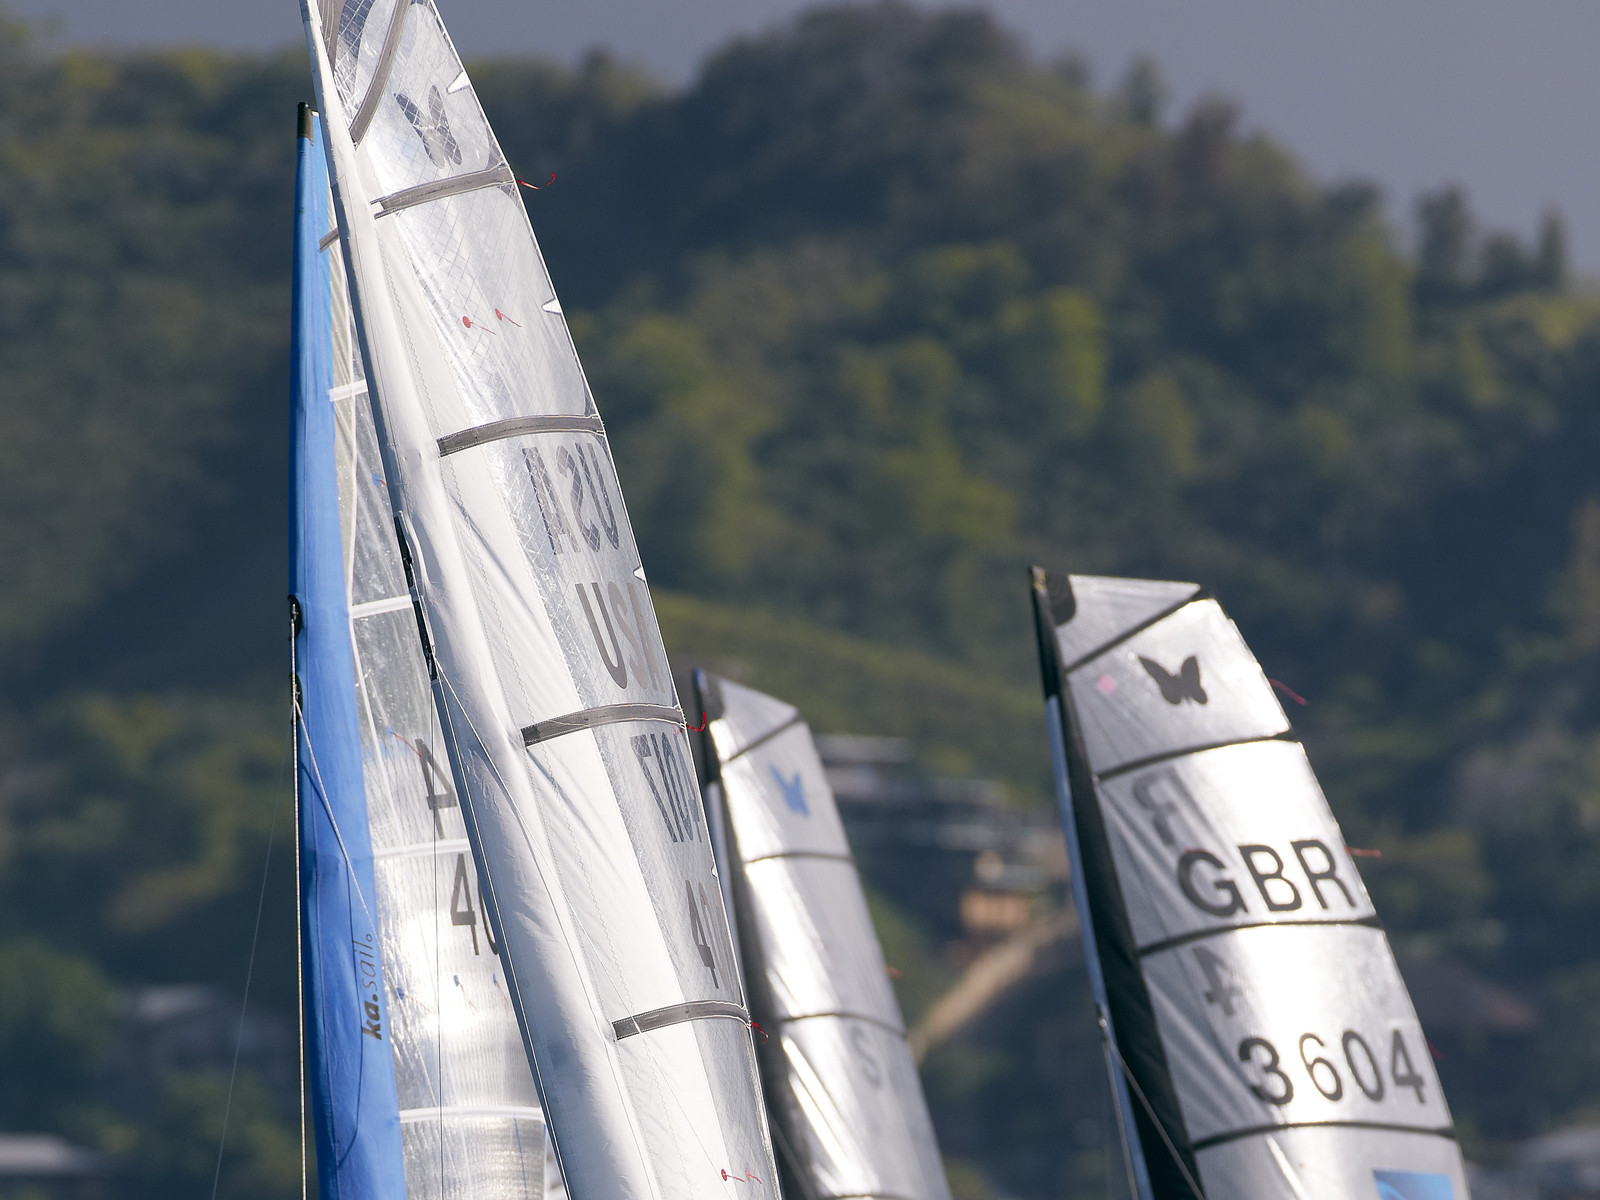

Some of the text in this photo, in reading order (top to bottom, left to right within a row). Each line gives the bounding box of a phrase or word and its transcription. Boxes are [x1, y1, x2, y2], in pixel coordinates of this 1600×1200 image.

[575, 581, 666, 693] USA
[450, 853, 499, 956] 4
[1177, 838, 1357, 917] GBR
[1238, 1029, 1426, 1106] 3604
